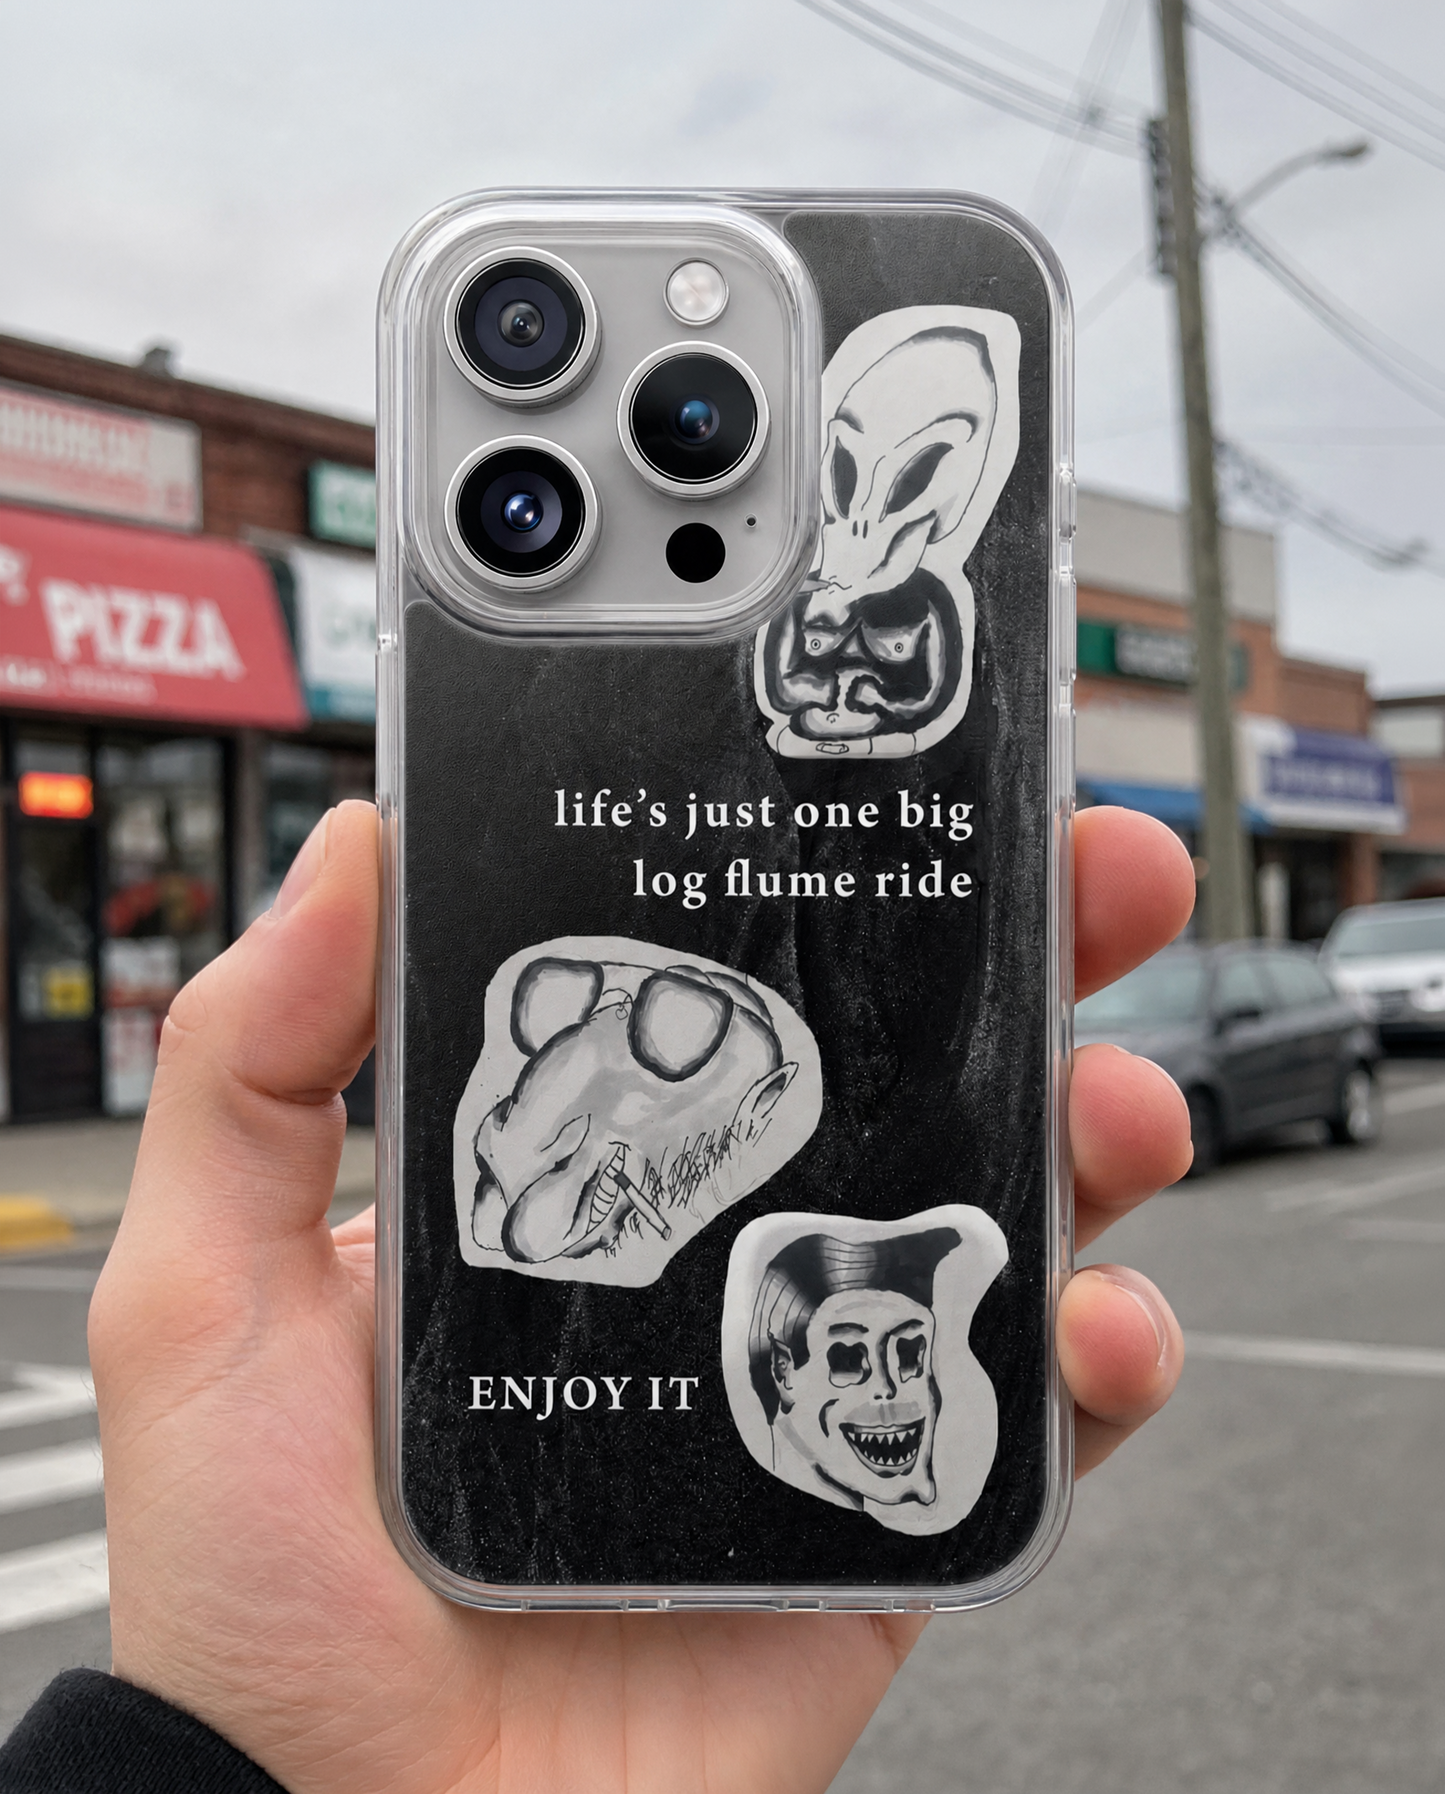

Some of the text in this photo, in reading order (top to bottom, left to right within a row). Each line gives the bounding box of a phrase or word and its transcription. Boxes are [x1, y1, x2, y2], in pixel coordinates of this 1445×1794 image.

[42, 579, 244, 680] PIZZA
[554, 788, 974, 841] life’s just one big
[633, 858, 974, 910] log flume ride
[468, 1375, 699, 1421] ENJOY IT
